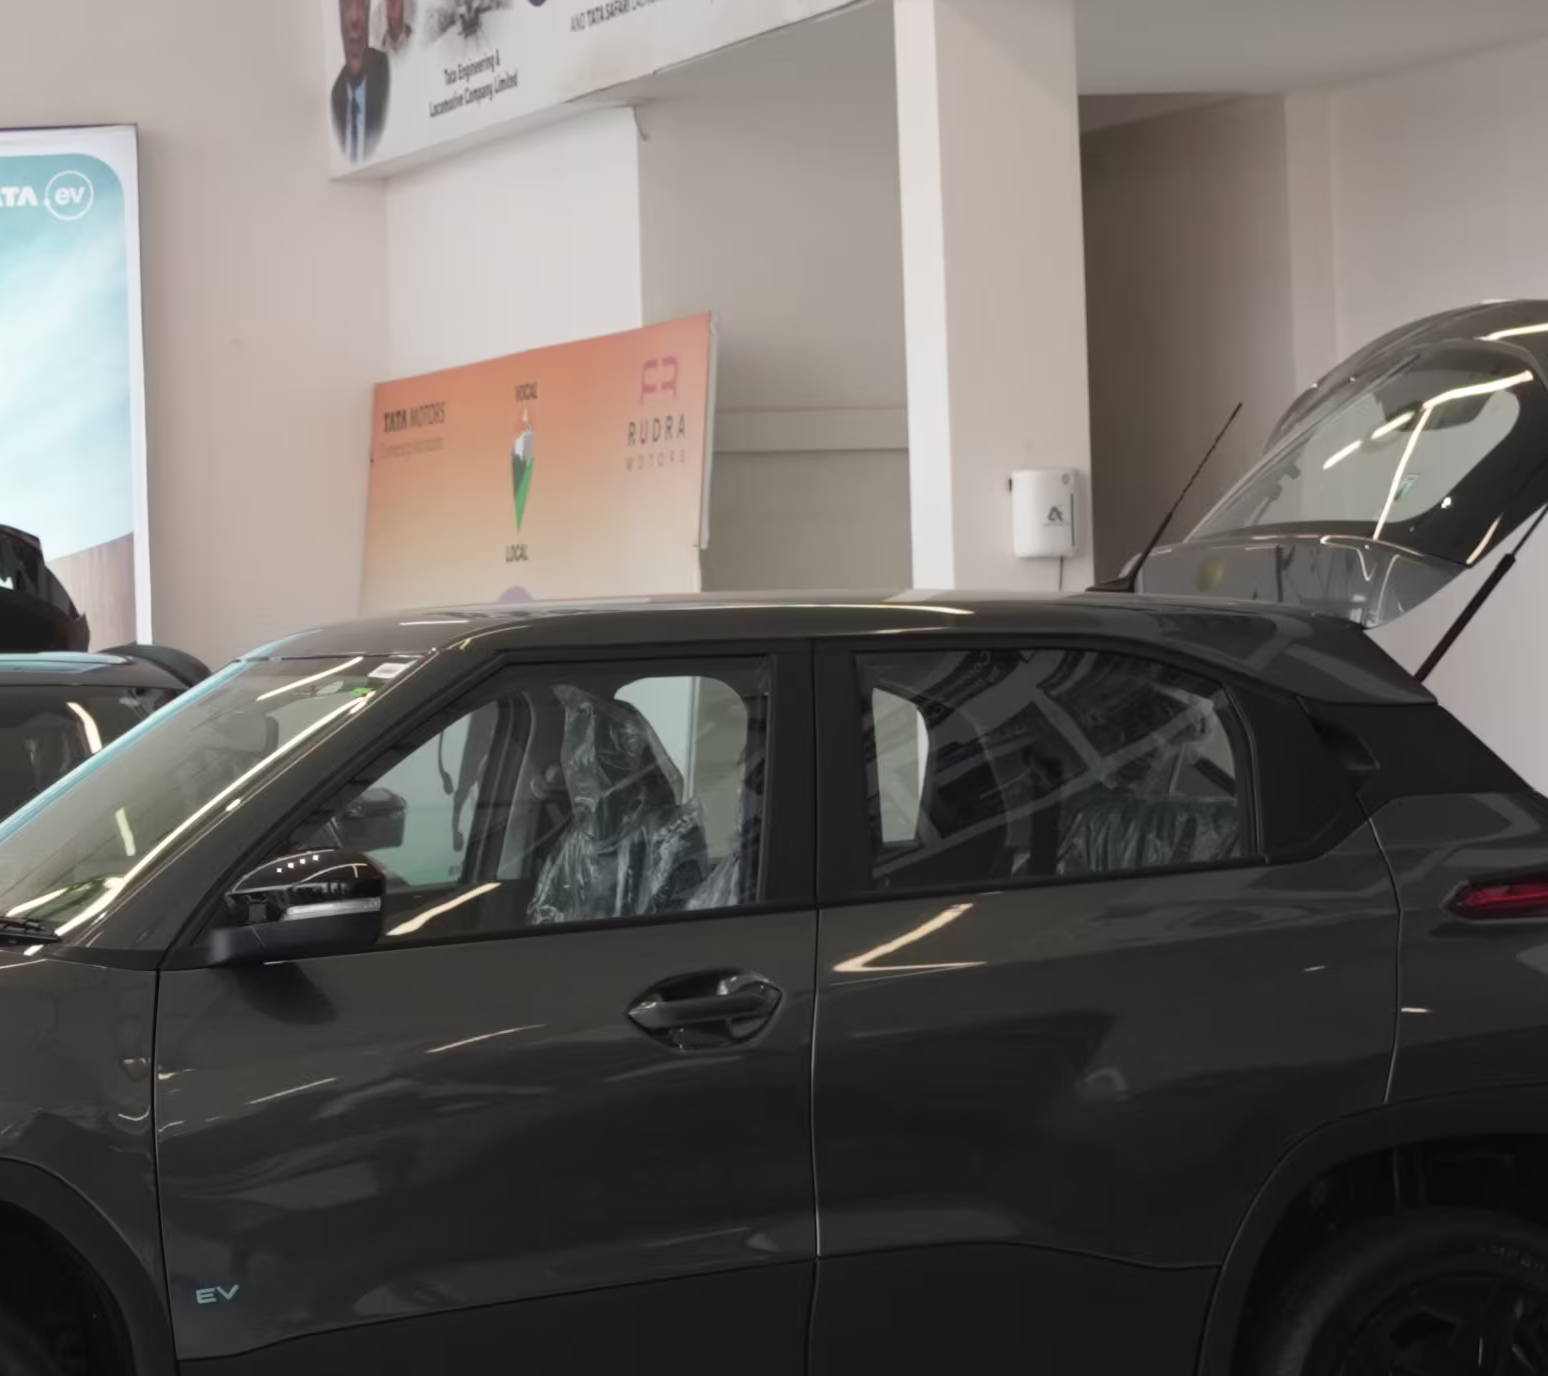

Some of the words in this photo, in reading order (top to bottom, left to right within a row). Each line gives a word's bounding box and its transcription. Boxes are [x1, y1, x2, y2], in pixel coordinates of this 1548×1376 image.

[586, 4, 604, 26] TATA
[458, 54, 494, 82] Engineering
[465, 84, 492, 105] Company
[494, 69, 518, 94] Limited
[515, 381, 537, 402] VOCAL
[384, 408, 408, 433] TATA
[409, 401, 446, 427] MOTORS
[627, 413, 686, 447] RUDRA
[505, 543, 528, 564] LOCAL
[196, 1284, 240, 1304] EV
